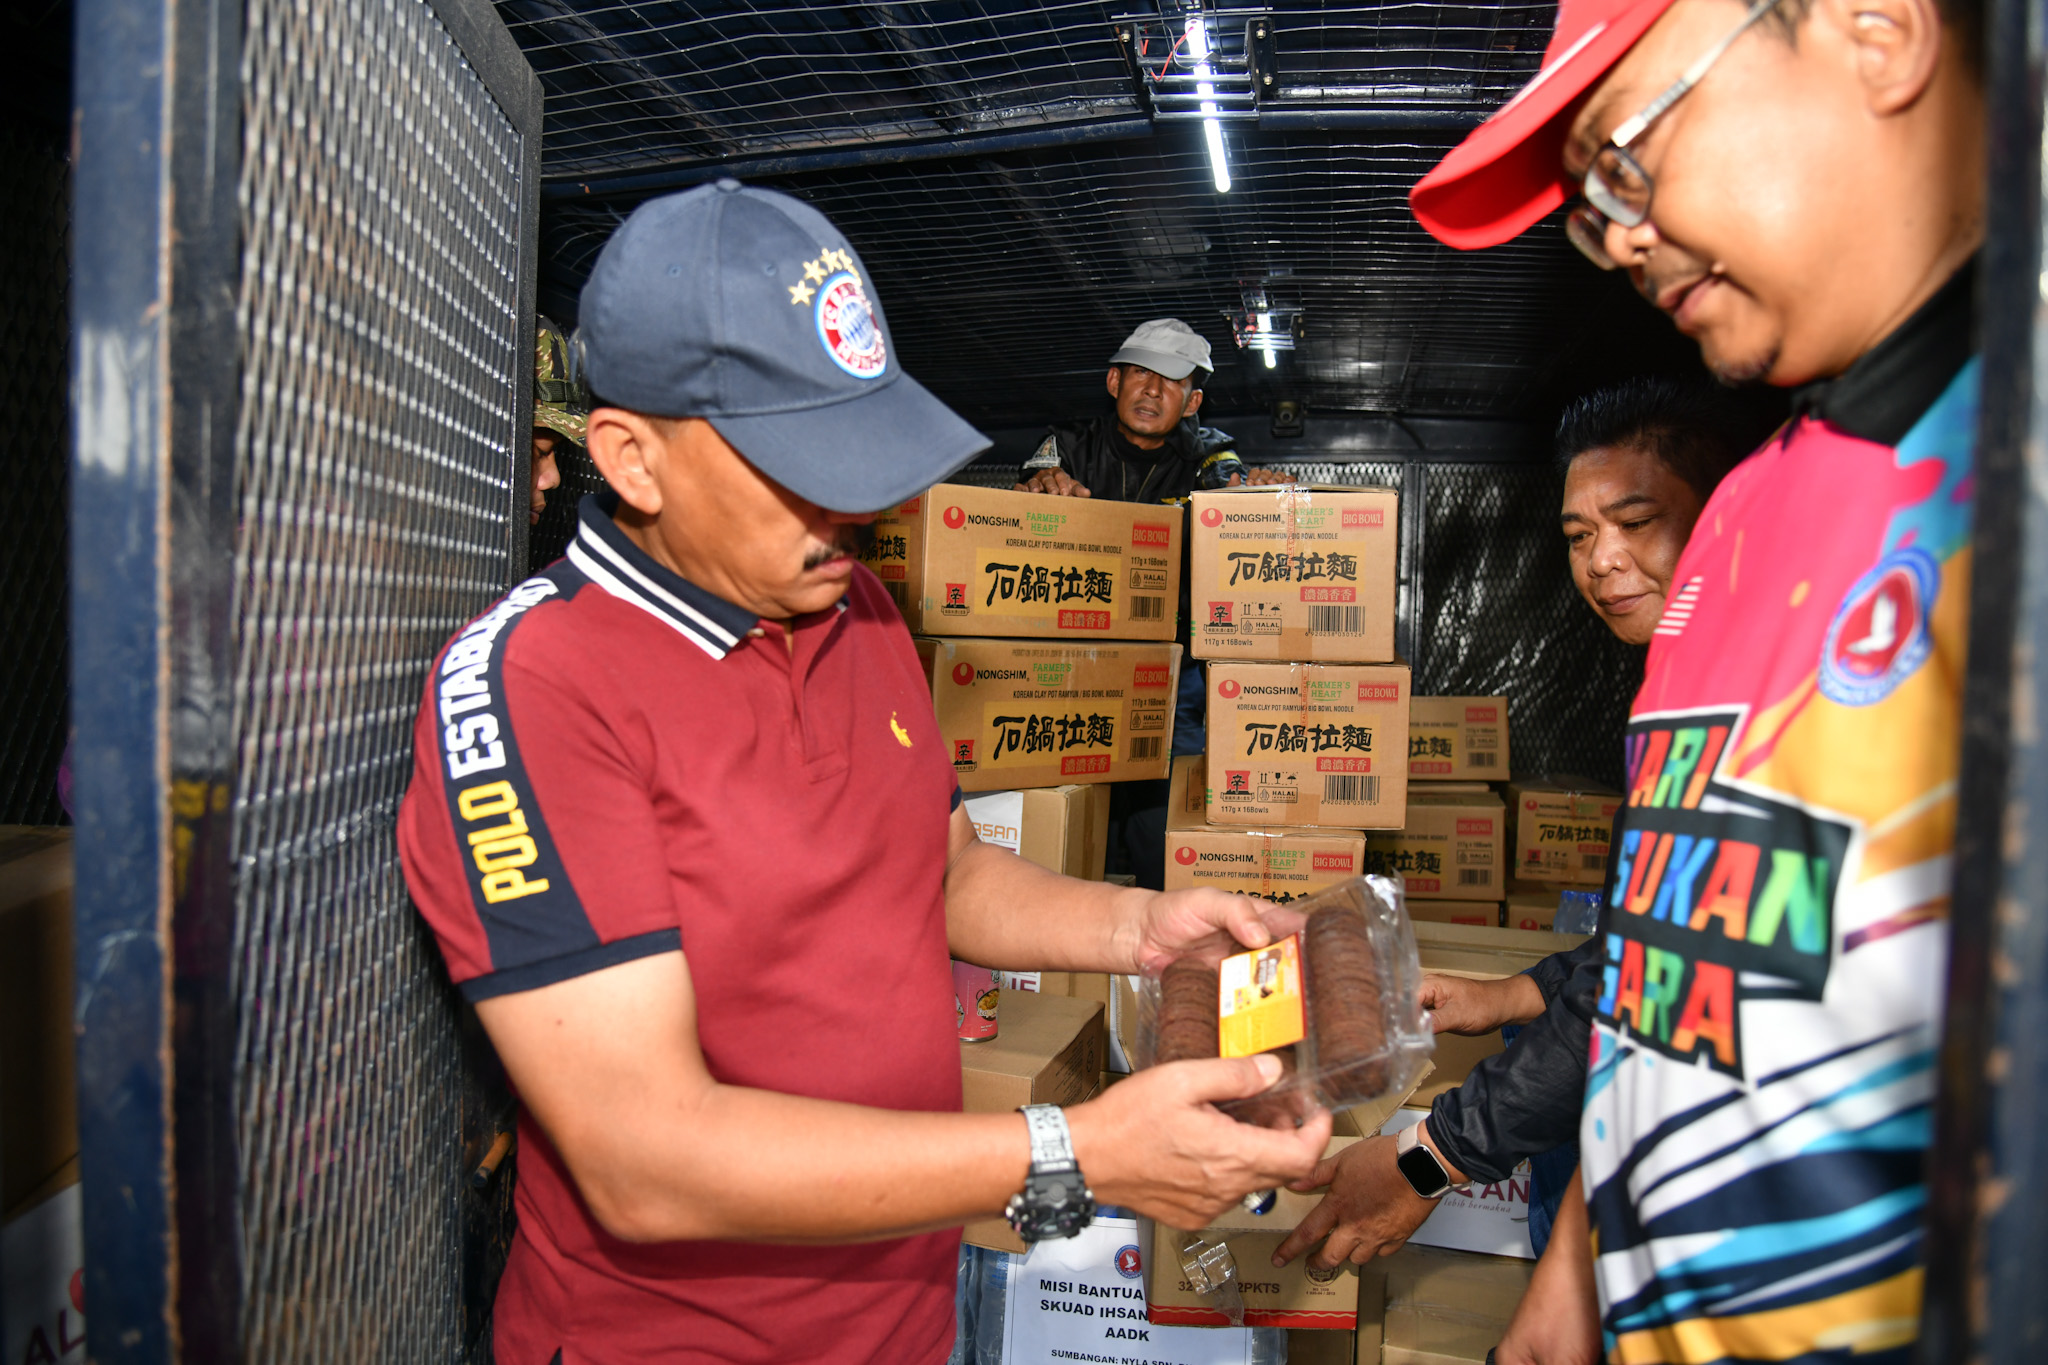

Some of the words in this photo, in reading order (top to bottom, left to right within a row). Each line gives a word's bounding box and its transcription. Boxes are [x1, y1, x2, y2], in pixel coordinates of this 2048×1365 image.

[967, 514, 1020, 528] NONGSHIM
[1026, 512, 1067, 524] FARMER'S
[1225, 513, 1281, 523] NONGSHIM
[1343, 514, 1357, 524] BIG
[1358, 514, 1383, 524] BOWL
[1031, 522, 1059, 533] HEART
[1133, 528, 1147, 541] BIG
[1147, 529, 1170, 544] BOWL
[1219, 532, 1240, 540] KOREAN
[1240, 532, 1253, 540] CLAY
[1254, 532, 1265, 540] POT
[1317, 532, 1338, 540] NOODLE
[1006, 538, 1027, 548] KOREAN
[1028, 539, 1041, 548] CLAY
[1041, 540, 1052, 549] POT
[1052, 541, 1075, 551] RAMYUN
[1078, 543, 1088, 551] BIG
[1088, 543, 1102, 553] BOWL
[1103, 544, 1122, 554] NOODLE
[1227, 551, 1357, 587] 石鍋拉麵
[1143, 573, 1165, 581] HALAL
[985, 562, 1113, 608] 石鍋拉麵
[1304, 589, 1352, 601] 濃濃香香
[1204, 638, 1219, 647] 117g
[1226, 638, 1253, 646] 16Bowls
[1032, 663, 1072, 673] FARMER'S
[976, 669, 1027, 680] NONGSHIM
[1037, 673, 1064, 683] HEART
[1135, 670, 1147, 683] BIG
[1148, 670, 1169, 684] BOWL
[1243, 686, 1299, 695] NONGSHIM
[1305, 680, 1351, 690] FARMER'S
[1013, 690, 1034, 699] KOREAN
[1034, 690, 1047, 699] CLAY
[1047, 690, 1057, 699] POT
[1058, 690, 1079, 698] RAMYUN
[1082, 689, 1091, 698] BIG
[1091, 689, 1105, 698] BOWL
[1106, 689, 1124, 698] NOODLE
[1311, 689, 1342, 698] HEART
[1359, 687, 1374, 698] BIG
[1374, 687, 1399, 698] BOWL
[1258, 704, 1270, 712] CLAY
[1271, 704, 1282, 712] POT
[1282, 704, 1305, 712] RAMYUN
[1333, 705, 1354, 713] NOODLE
[992, 712, 1114, 761] 石鍋拉麵
[1245, 722, 1373, 756] 石鍋拉麵
[1320, 758, 1367, 771] 濃濃香香
[1221, 805, 1236, 814] 117g
[1243, 806, 1269, 814] 16Bowls
[457, 780, 550, 904] POLO
[1200, 852, 1254, 863] NONGSHIM
[1260, 849, 1306, 858] FARMER'S
[1314, 857, 1328, 867] BIG
[1329, 858, 1353, 868] BOWL
[1213, 870, 1226, 878] CLAY
[1238, 871, 1260, 879] RAMYUN
[1288, 873, 1309, 881] NOODLE
[1468, 1201, 1511, 1213] bermakna
[1040, 1279, 1073, 1293] MISI
[1040, 1300, 1094, 1316] SKUAD
[1105, 1327, 1150, 1342] AADK
[1051, 1349, 1118, 1365] SUMBANGAN:
